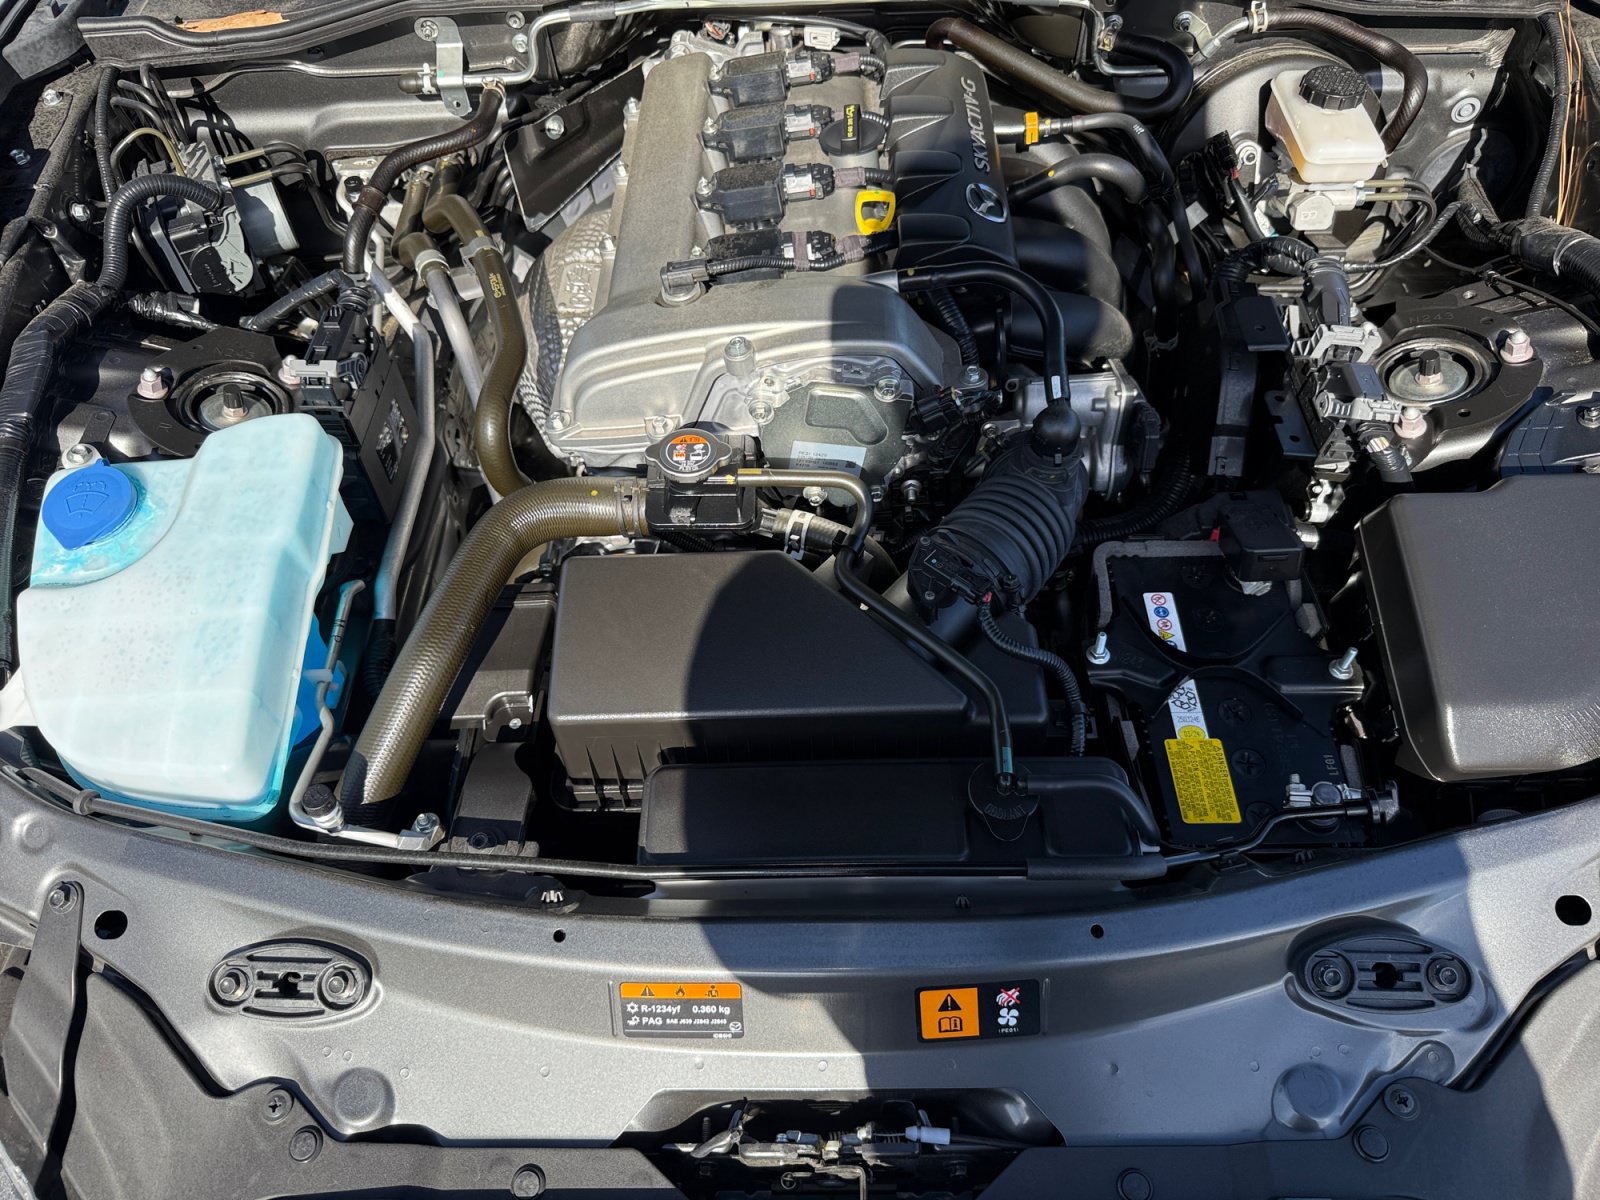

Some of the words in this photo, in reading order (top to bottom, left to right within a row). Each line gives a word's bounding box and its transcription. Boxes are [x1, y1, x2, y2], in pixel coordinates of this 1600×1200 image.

[961, 76, 991, 173] SKYACTIV-G
[1409, 311, 1455, 324] N243
[1215, 753, 1228, 777] DANGER
[641, 1004, 680, 1014] R-1234yf
[692, 1005, 716, 1013] 0.360
[718, 1004, 730, 1015] kg
[642, 1017, 662, 1025] PAG
